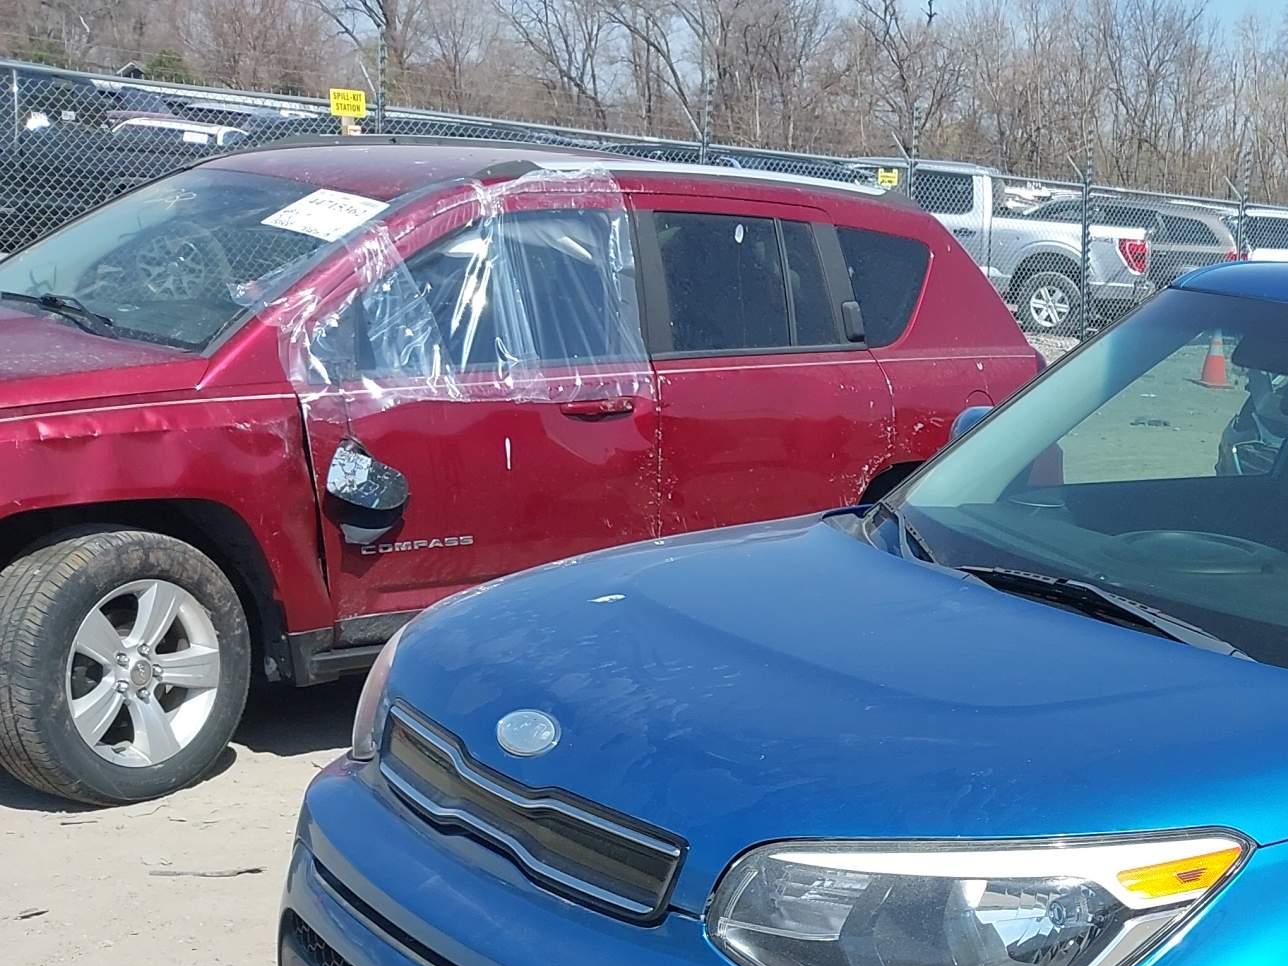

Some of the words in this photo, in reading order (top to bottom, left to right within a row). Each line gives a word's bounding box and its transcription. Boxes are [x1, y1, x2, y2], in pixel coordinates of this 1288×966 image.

[332, 92, 362, 102] SPILL-KIT
[335, 103, 361, 112] STATION
[361, 535, 474, 555] COMPASS
